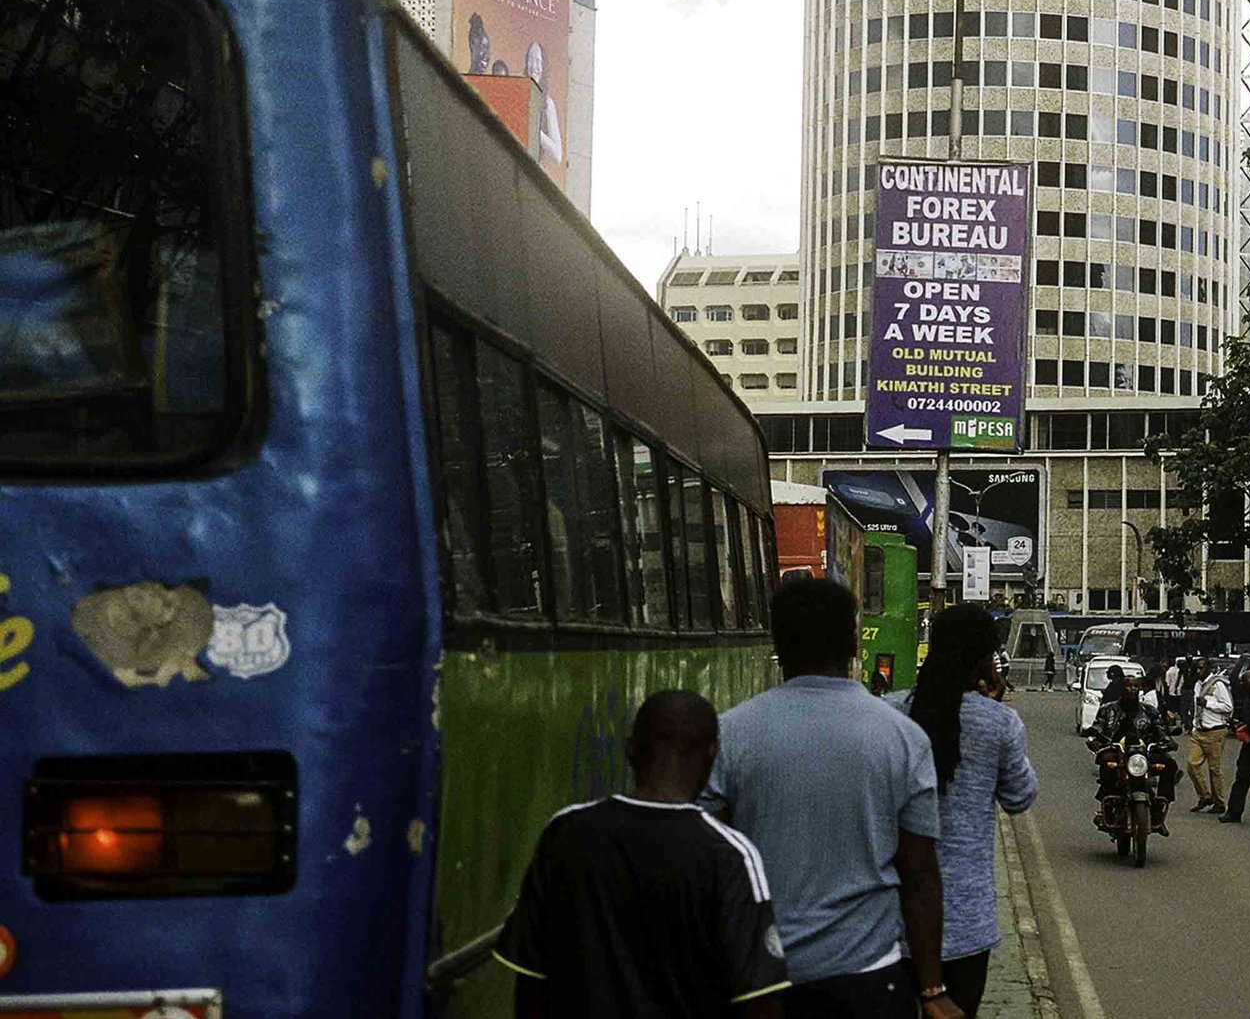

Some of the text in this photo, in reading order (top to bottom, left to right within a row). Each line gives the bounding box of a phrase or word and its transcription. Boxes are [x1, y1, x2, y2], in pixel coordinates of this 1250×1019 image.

[881, 164, 1025, 196] CONTINENTAL
[907, 196, 997, 222] FOREX
[892, 221, 1008, 250] BUREAU
[903, 281, 980, 301] OPEN
[894, 303, 991, 323] 7 DAYS
[884, 323, 994, 344] A WEEK
[892, 347, 997, 363] OLD MUTUAL
[905, 364, 984, 378] BUILDING
[877, 380, 1012, 396] KIMATHI STREET
[907, 397, 1001, 413] 0724400002
[867, 523, 880, 531] S25
[880, 523, 898, 531] Ultra
[1014, 540, 1026, 550] 24
